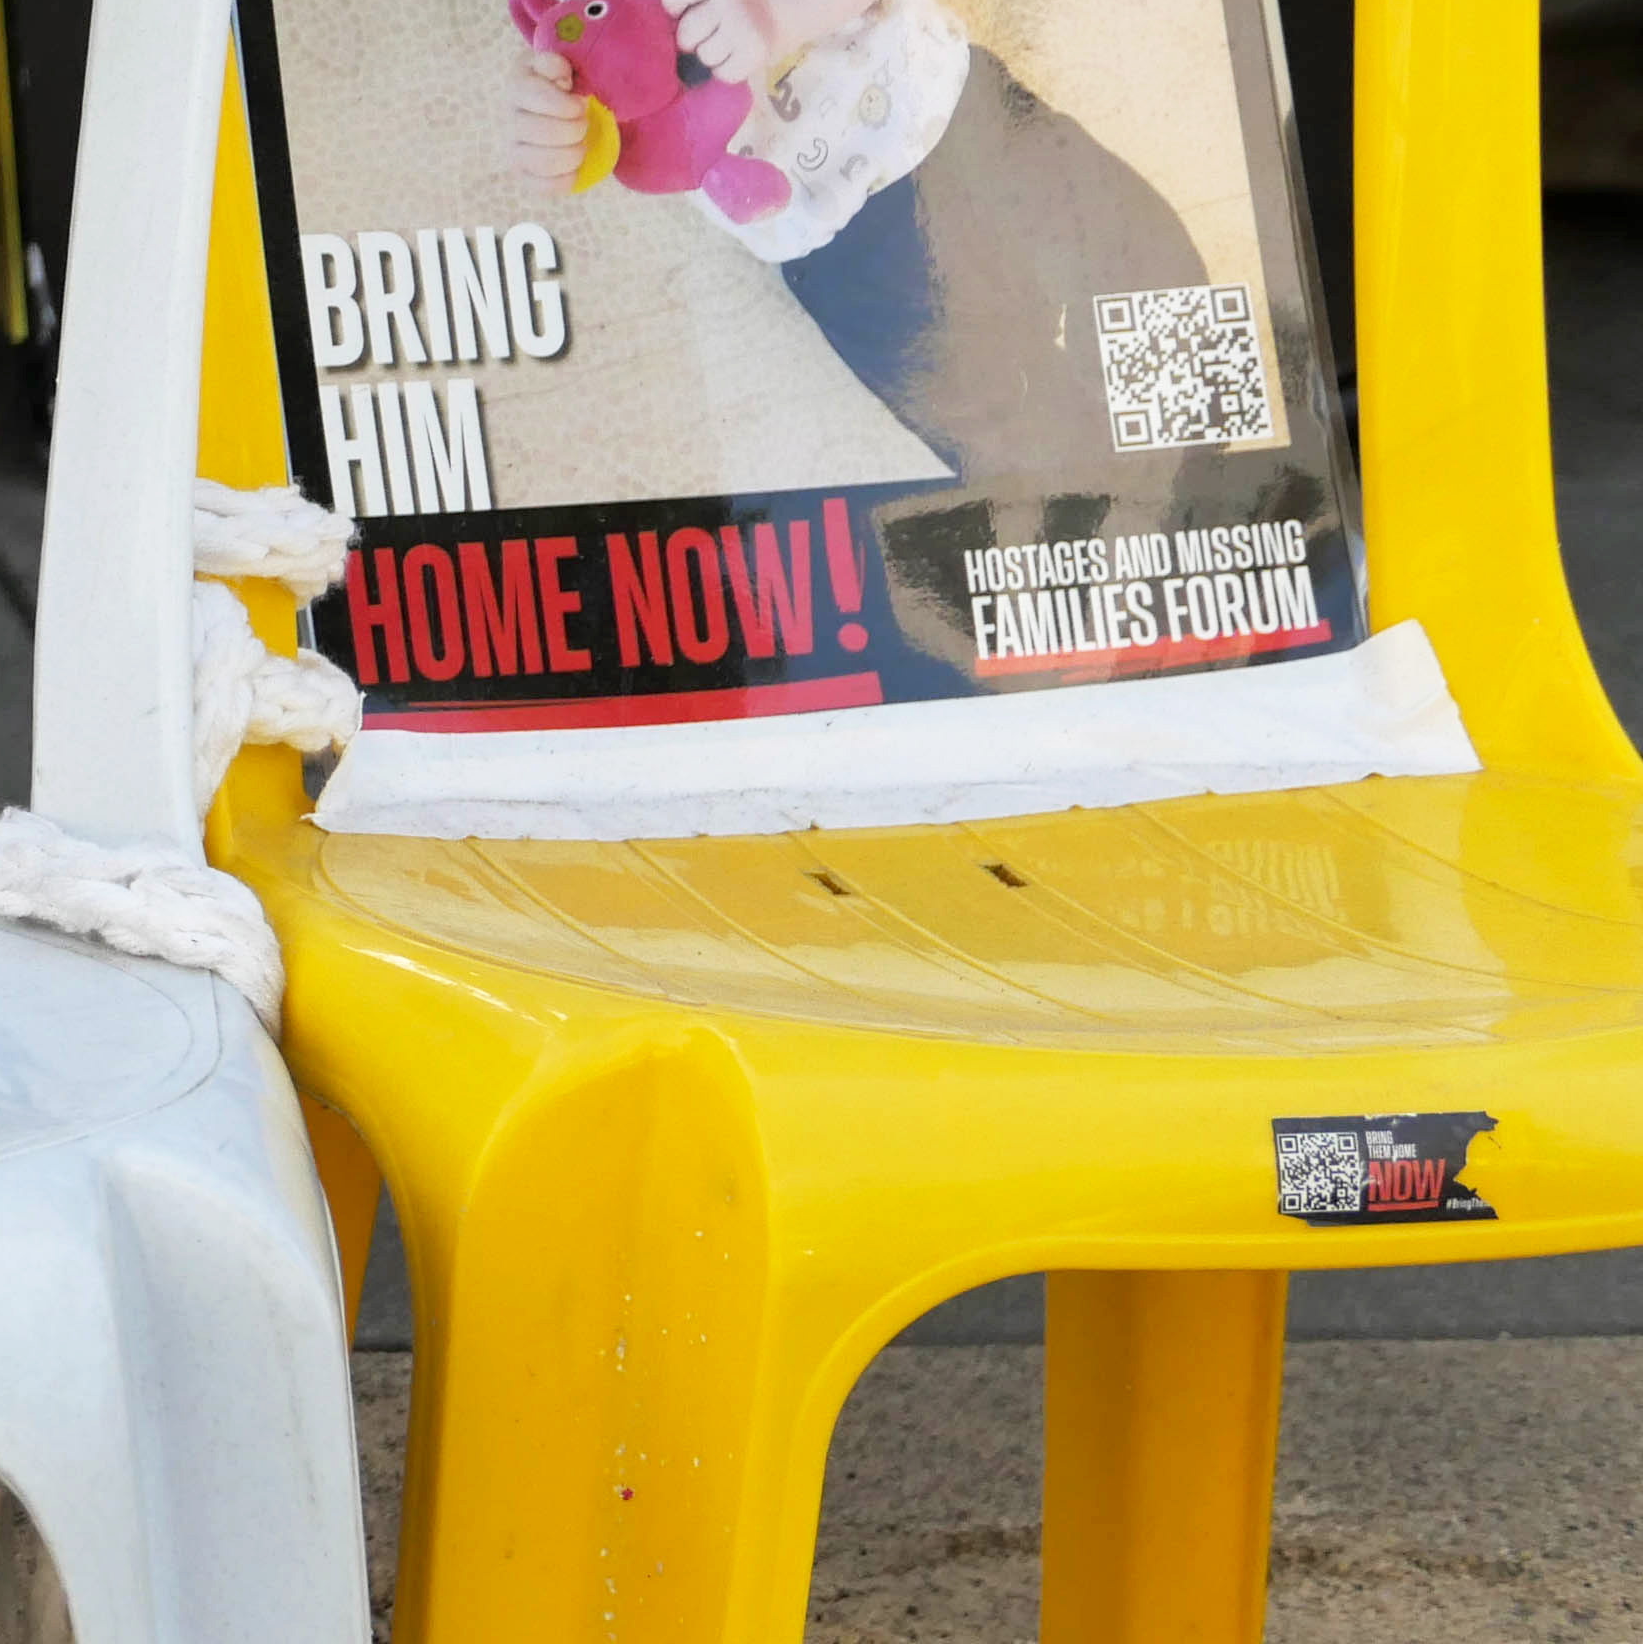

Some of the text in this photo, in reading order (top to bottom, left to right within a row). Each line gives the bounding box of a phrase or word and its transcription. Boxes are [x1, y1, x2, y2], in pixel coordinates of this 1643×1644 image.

[300, 222, 567, 369] BRING
[320, 378, 493, 519] HIM
[345, 497, 870, 686] HOME NOW!
[964, 519, 1307, 595] HOSTAGES AND MISSING
[971, 565, 1319, 661] FAMILIES FORUM
[1367, 1158, 1446, 1202] NOW
